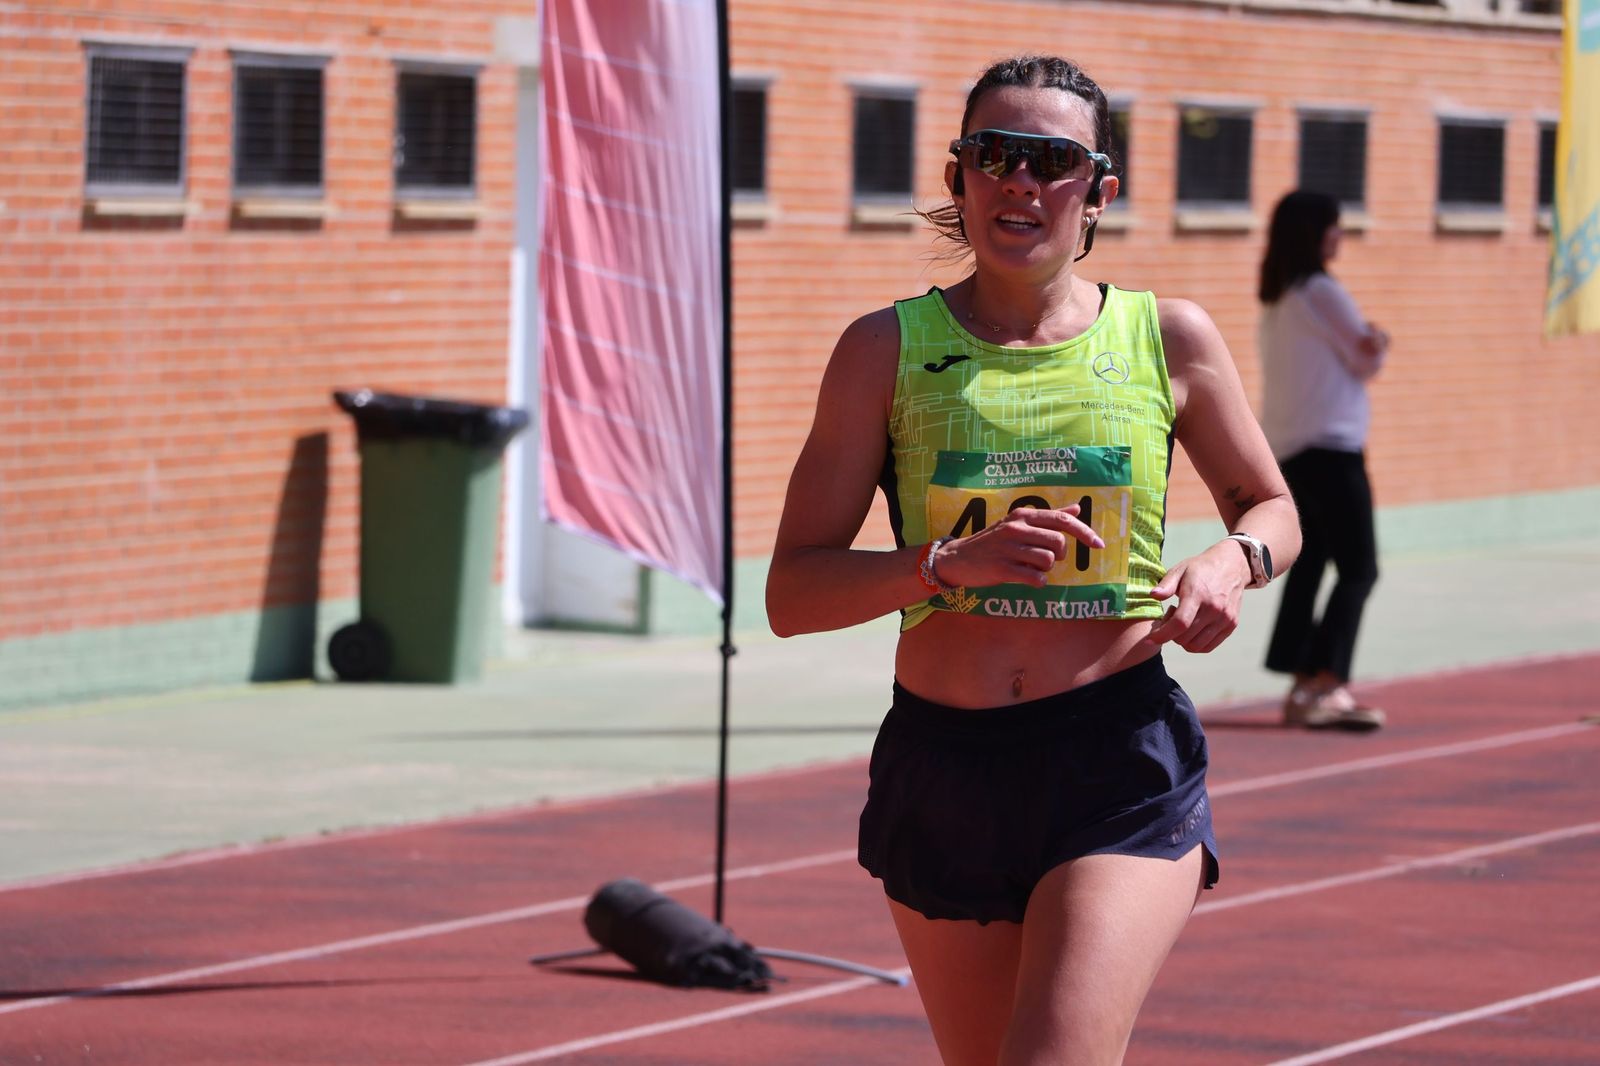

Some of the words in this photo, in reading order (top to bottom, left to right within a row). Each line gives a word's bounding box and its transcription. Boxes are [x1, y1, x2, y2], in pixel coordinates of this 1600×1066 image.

[1081, 401, 1145, 416] Mercedes-Benz
[984, 464, 1021, 477] CAJA
[1025, 461, 1077, 474] RURAL
[984, 478, 997, 486] DE
[1000, 476, 1035, 485] ZAMORA
[949, 495, 1092, 572] 41
[984, 598, 1040, 618] CAJA
[1046, 599, 1115, 619] RURAL
